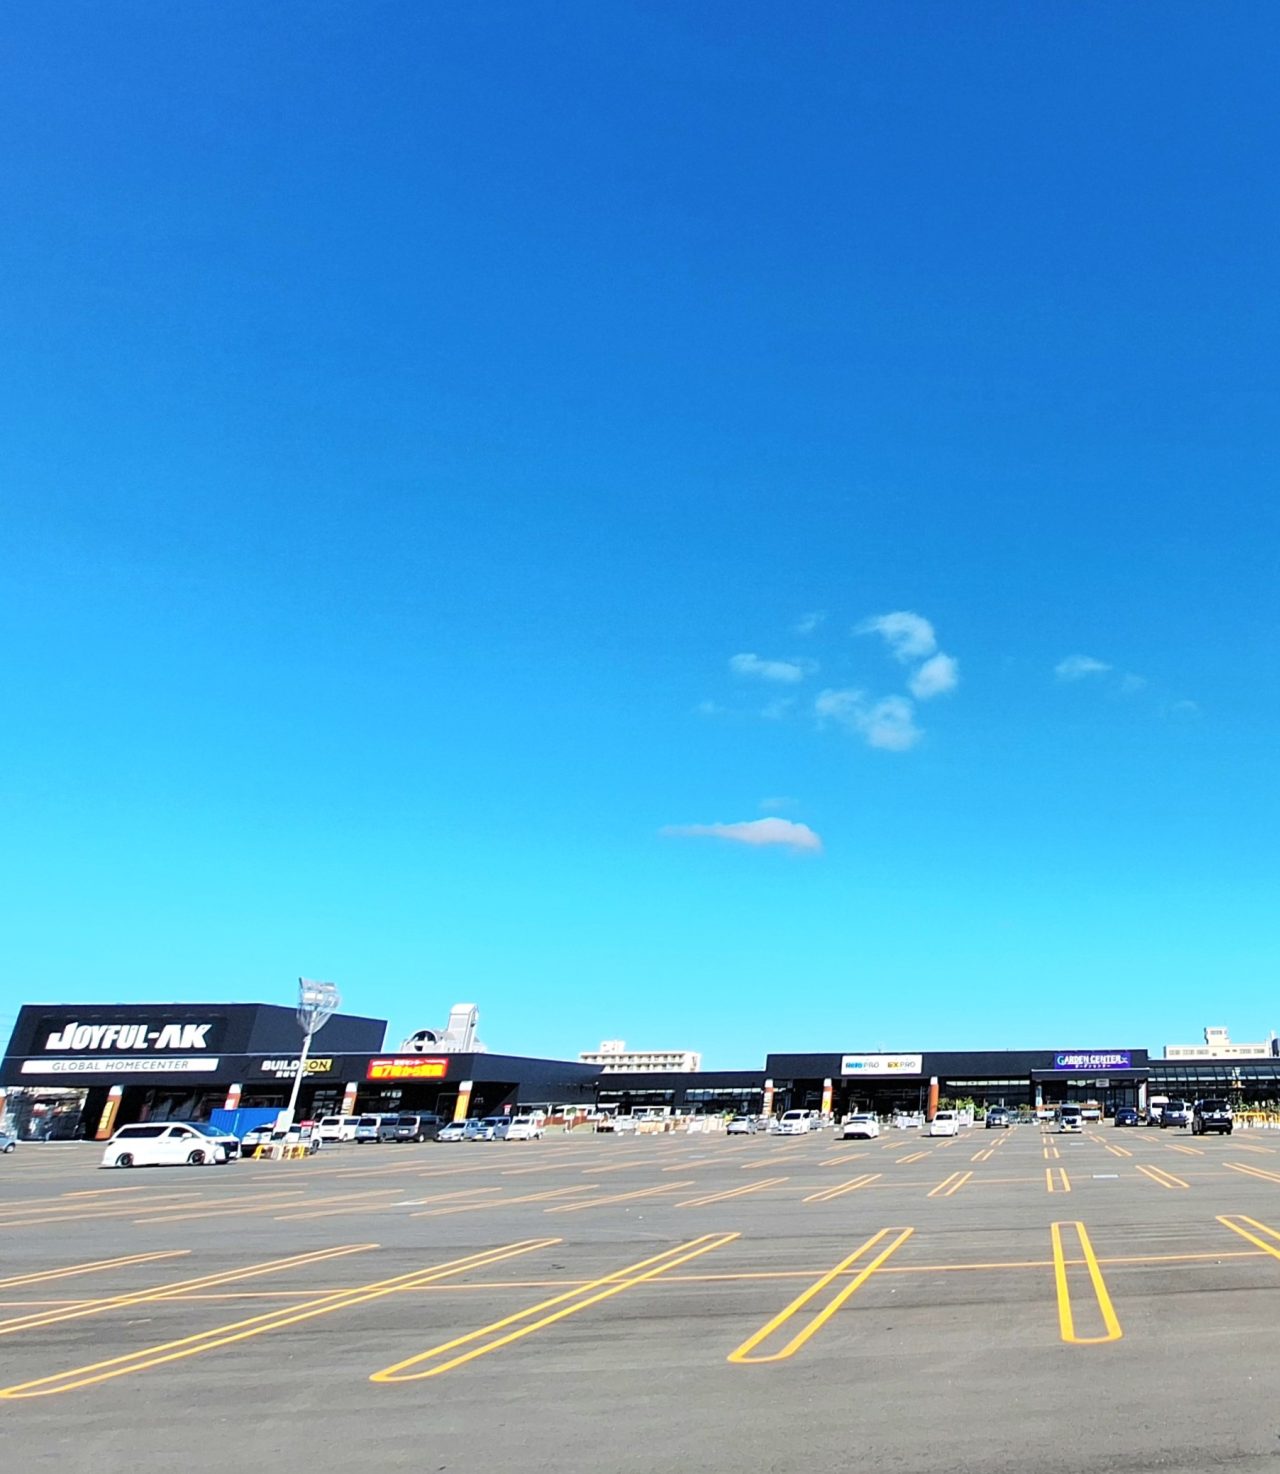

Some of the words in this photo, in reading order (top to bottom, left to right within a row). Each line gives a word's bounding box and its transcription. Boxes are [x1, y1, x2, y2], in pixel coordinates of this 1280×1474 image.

[45, 1022, 212, 1050] JOYFUL-AK
[52, 1062, 100, 1072] GLOBAL
[105, 1060, 189, 1071] HOMECENTER
[1057, 1055, 1089, 1066] GARDEN
[1090, 1054, 1121, 1065] CENTER
